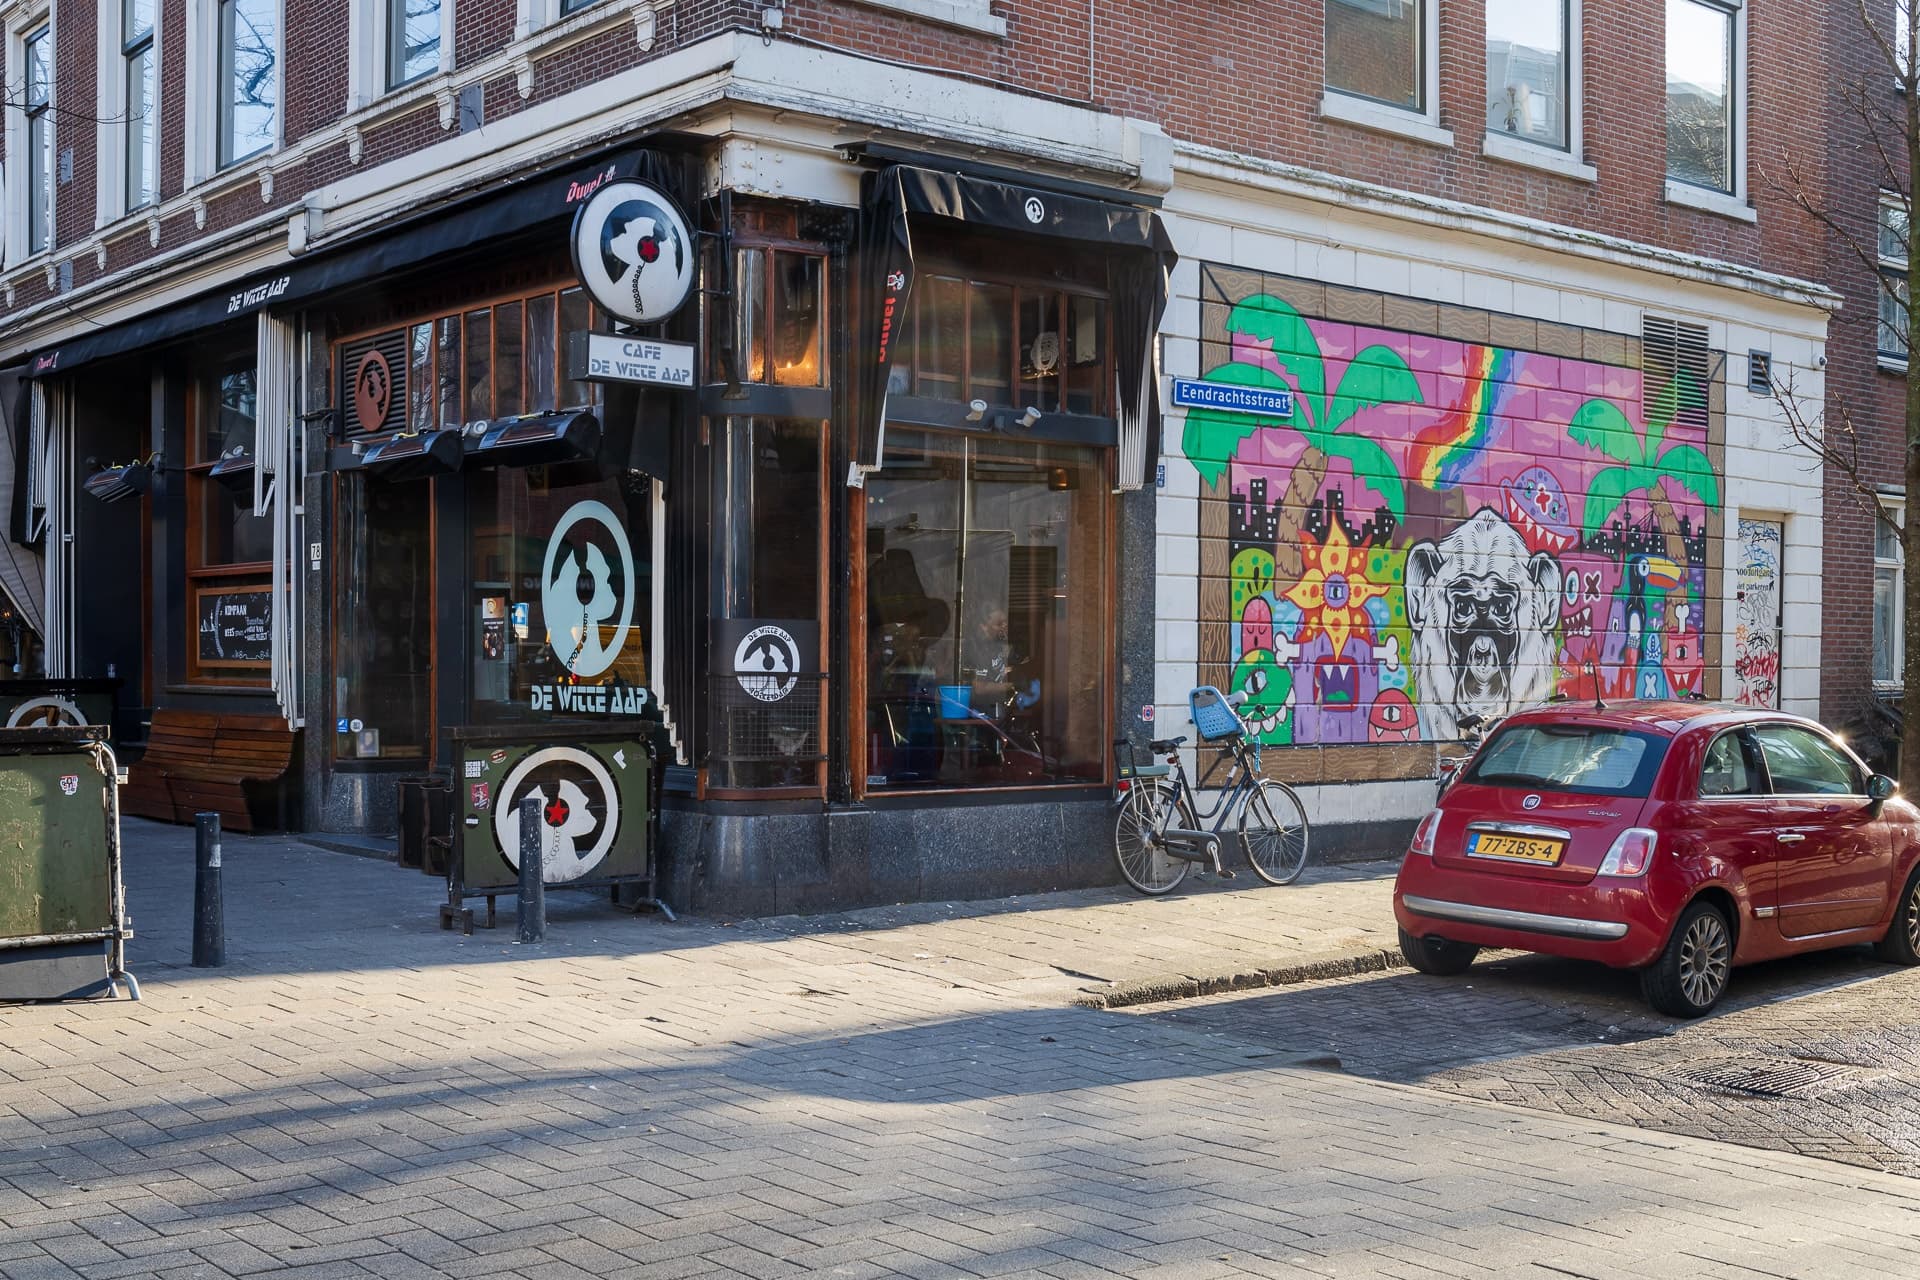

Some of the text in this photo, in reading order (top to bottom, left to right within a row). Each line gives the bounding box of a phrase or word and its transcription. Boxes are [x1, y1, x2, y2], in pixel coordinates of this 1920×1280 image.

[227, 293, 243, 314] DE
[266, 276, 290, 299] AAP
[591, 358, 610, 375] DE
[660, 367, 691, 384] AAP
[1181, 383, 1287, 409] Eendrachtsstraat
[311, 545, 321, 559] 78
[531, 684, 553, 711] DE
[610, 686, 648, 715] AAP
